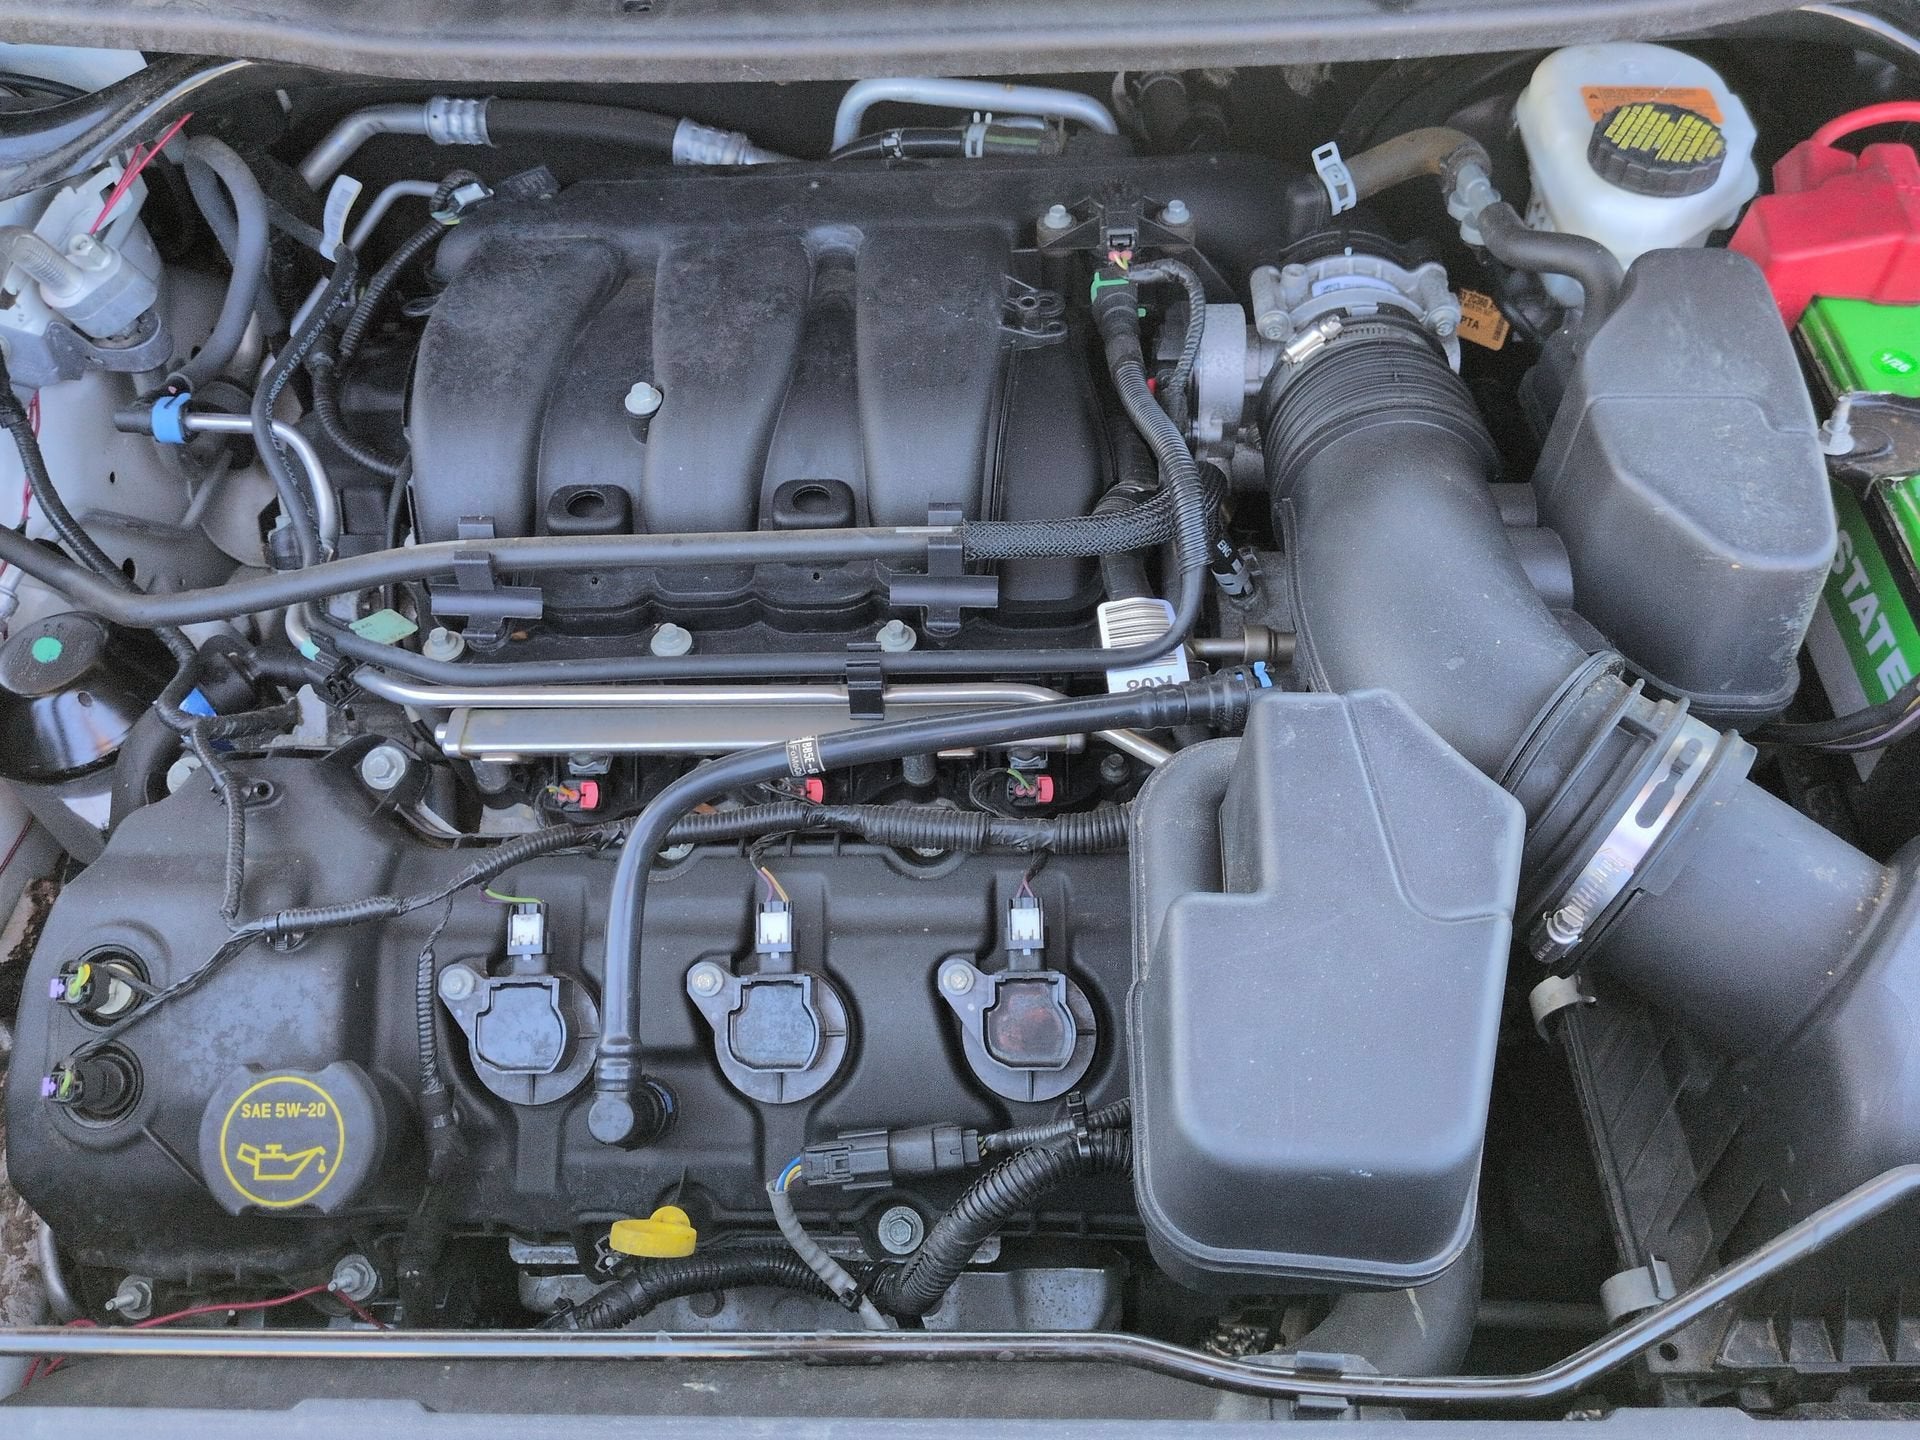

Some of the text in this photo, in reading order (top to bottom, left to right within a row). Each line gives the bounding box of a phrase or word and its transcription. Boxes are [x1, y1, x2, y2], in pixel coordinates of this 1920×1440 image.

[1217, 539, 1233, 558] ENG
[241, 1102, 326, 1118] SAE 5W-20
